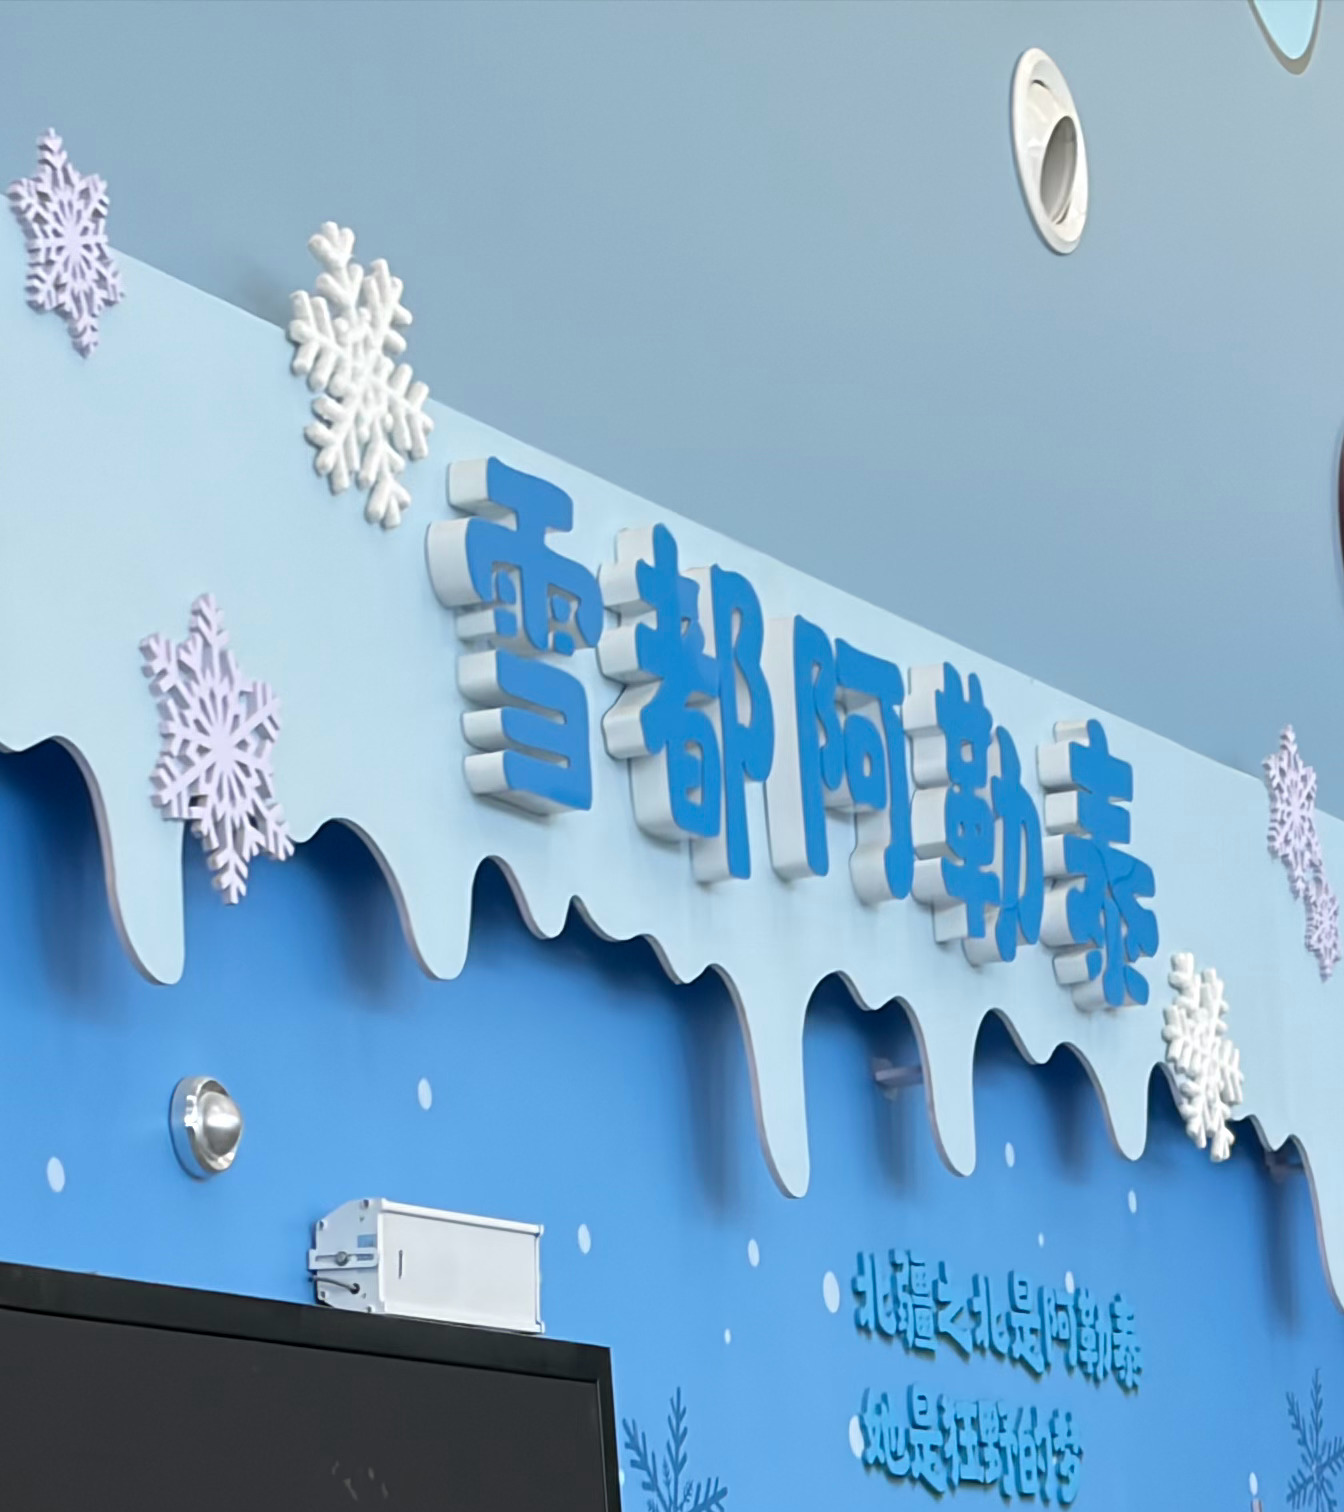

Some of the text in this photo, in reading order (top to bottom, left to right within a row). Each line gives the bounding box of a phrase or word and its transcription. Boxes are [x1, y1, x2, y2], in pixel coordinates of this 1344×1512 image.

[428, 456, 1159, 1010] 雪都阿勒泰
[852, 1248, 1143, 1391] 北疆之北是阿勒泰
